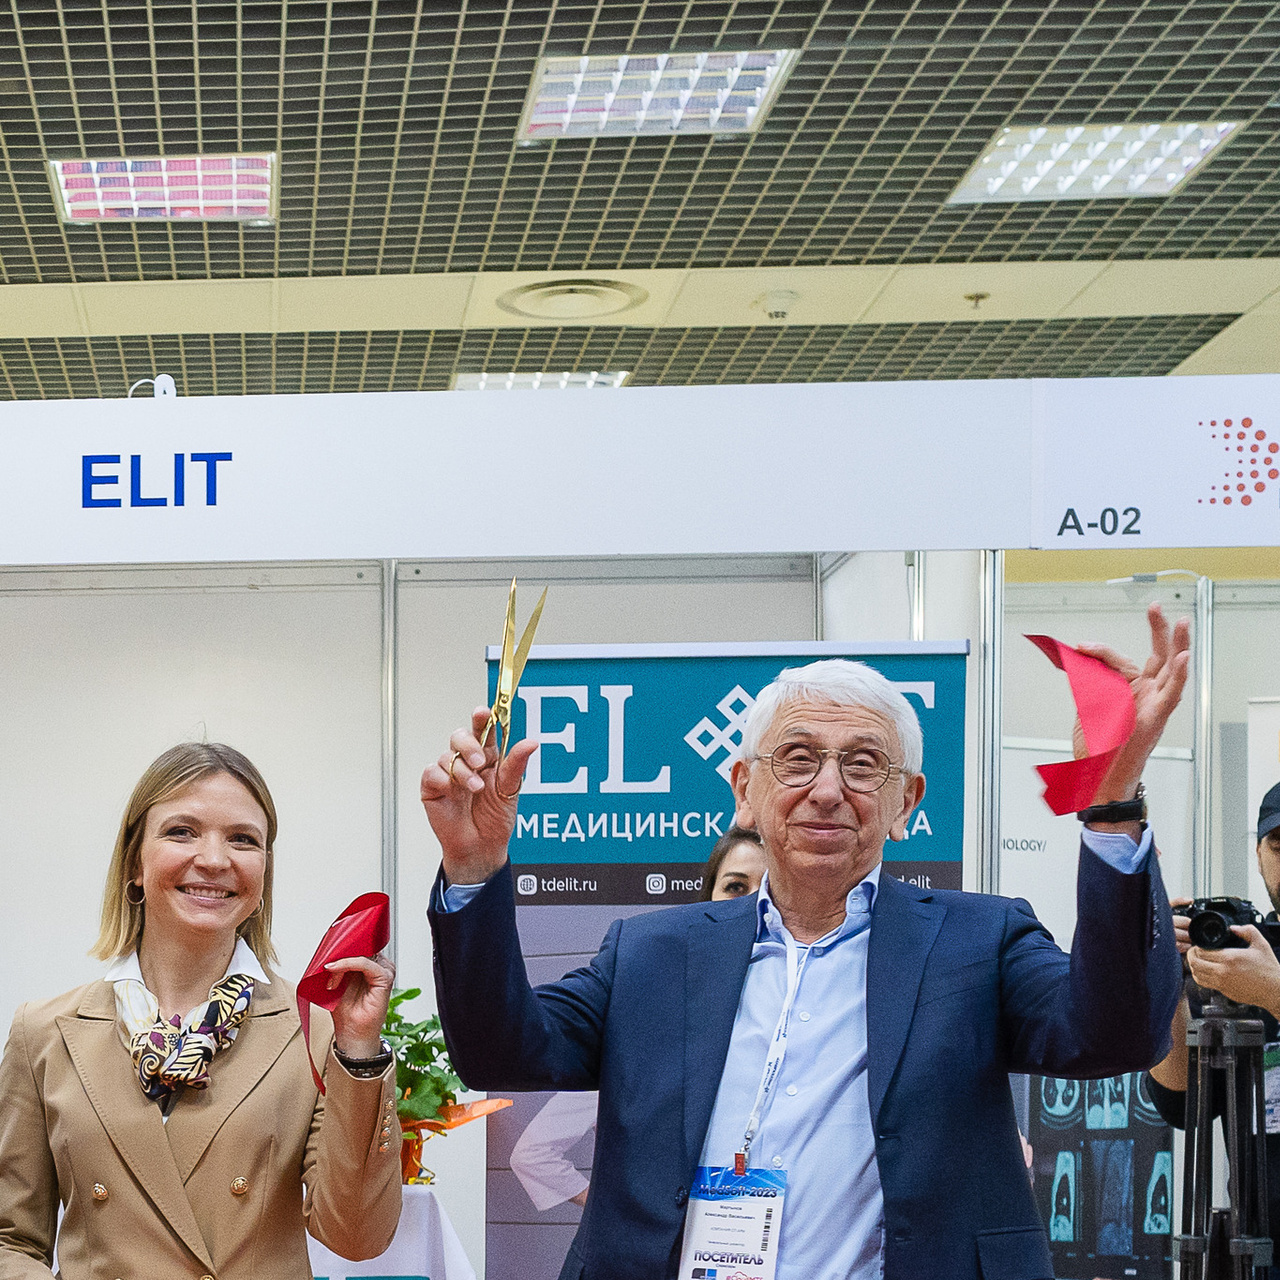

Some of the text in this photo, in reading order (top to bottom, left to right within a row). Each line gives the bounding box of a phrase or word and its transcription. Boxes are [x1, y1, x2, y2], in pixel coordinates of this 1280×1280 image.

[81, 451, 233, 509] ELIT
[1057, 507, 1142, 536] A-02
[516, 811, 735, 842] МЕДИЦИНСК
[541, 877, 598, 892] tdelit.ru
[698, 1185, 778, 1198] MedSoft-2023
[694, 1250, 763, 1265] ПОСЕТИТЕЛЬ
